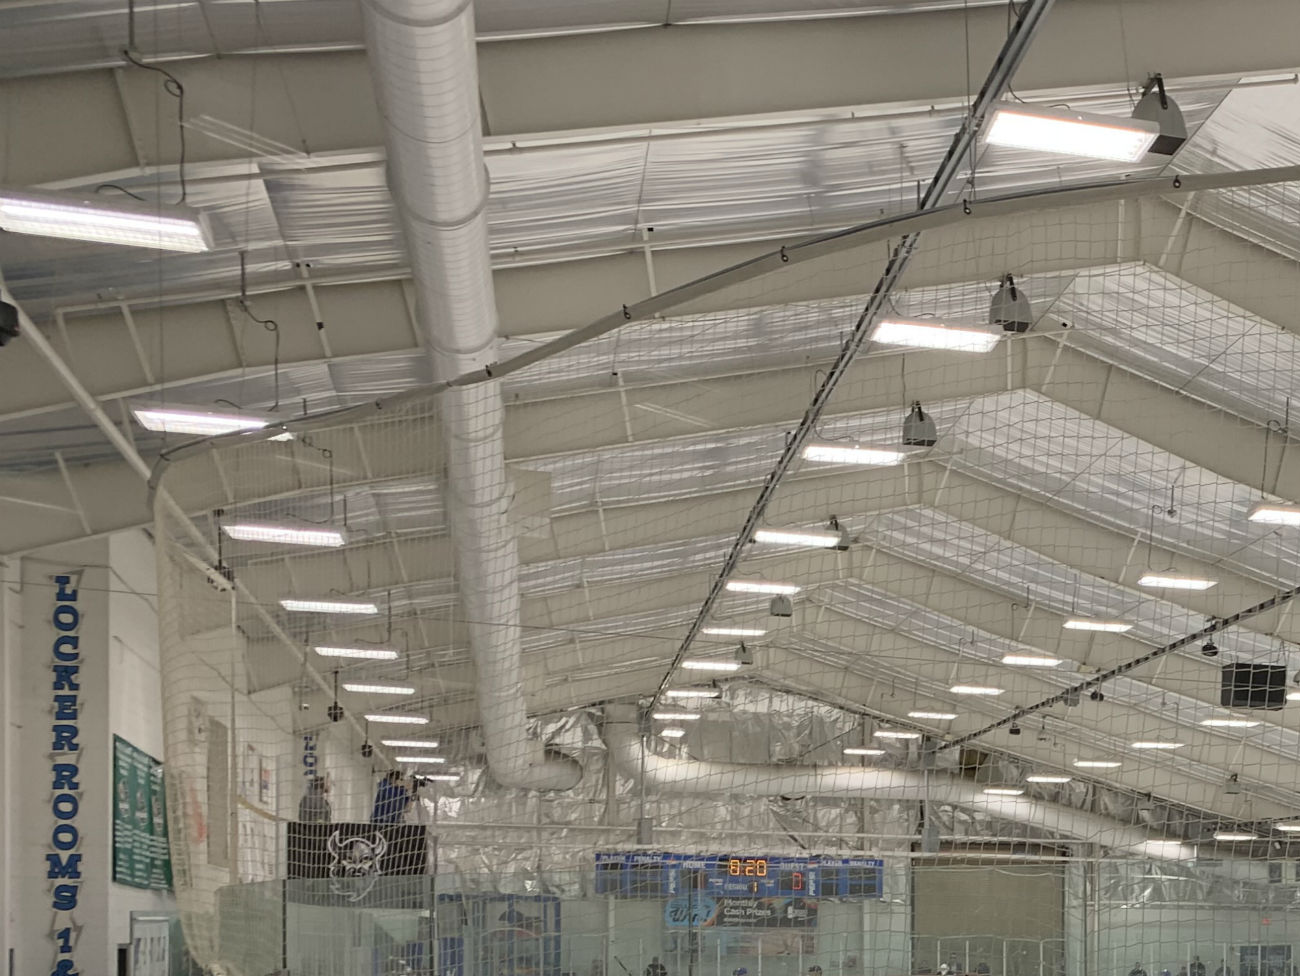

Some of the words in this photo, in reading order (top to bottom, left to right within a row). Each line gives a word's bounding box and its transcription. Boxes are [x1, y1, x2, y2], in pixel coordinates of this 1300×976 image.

[53, 575, 80, 752] LOCKER
[45, 763, 82, 911] ROOMS
[729, 859, 767, 876] 8:20
[723, 907, 745, 915] Cash
[746, 908, 771, 916] Prizes
[724, 898, 759, 909] Monthly
